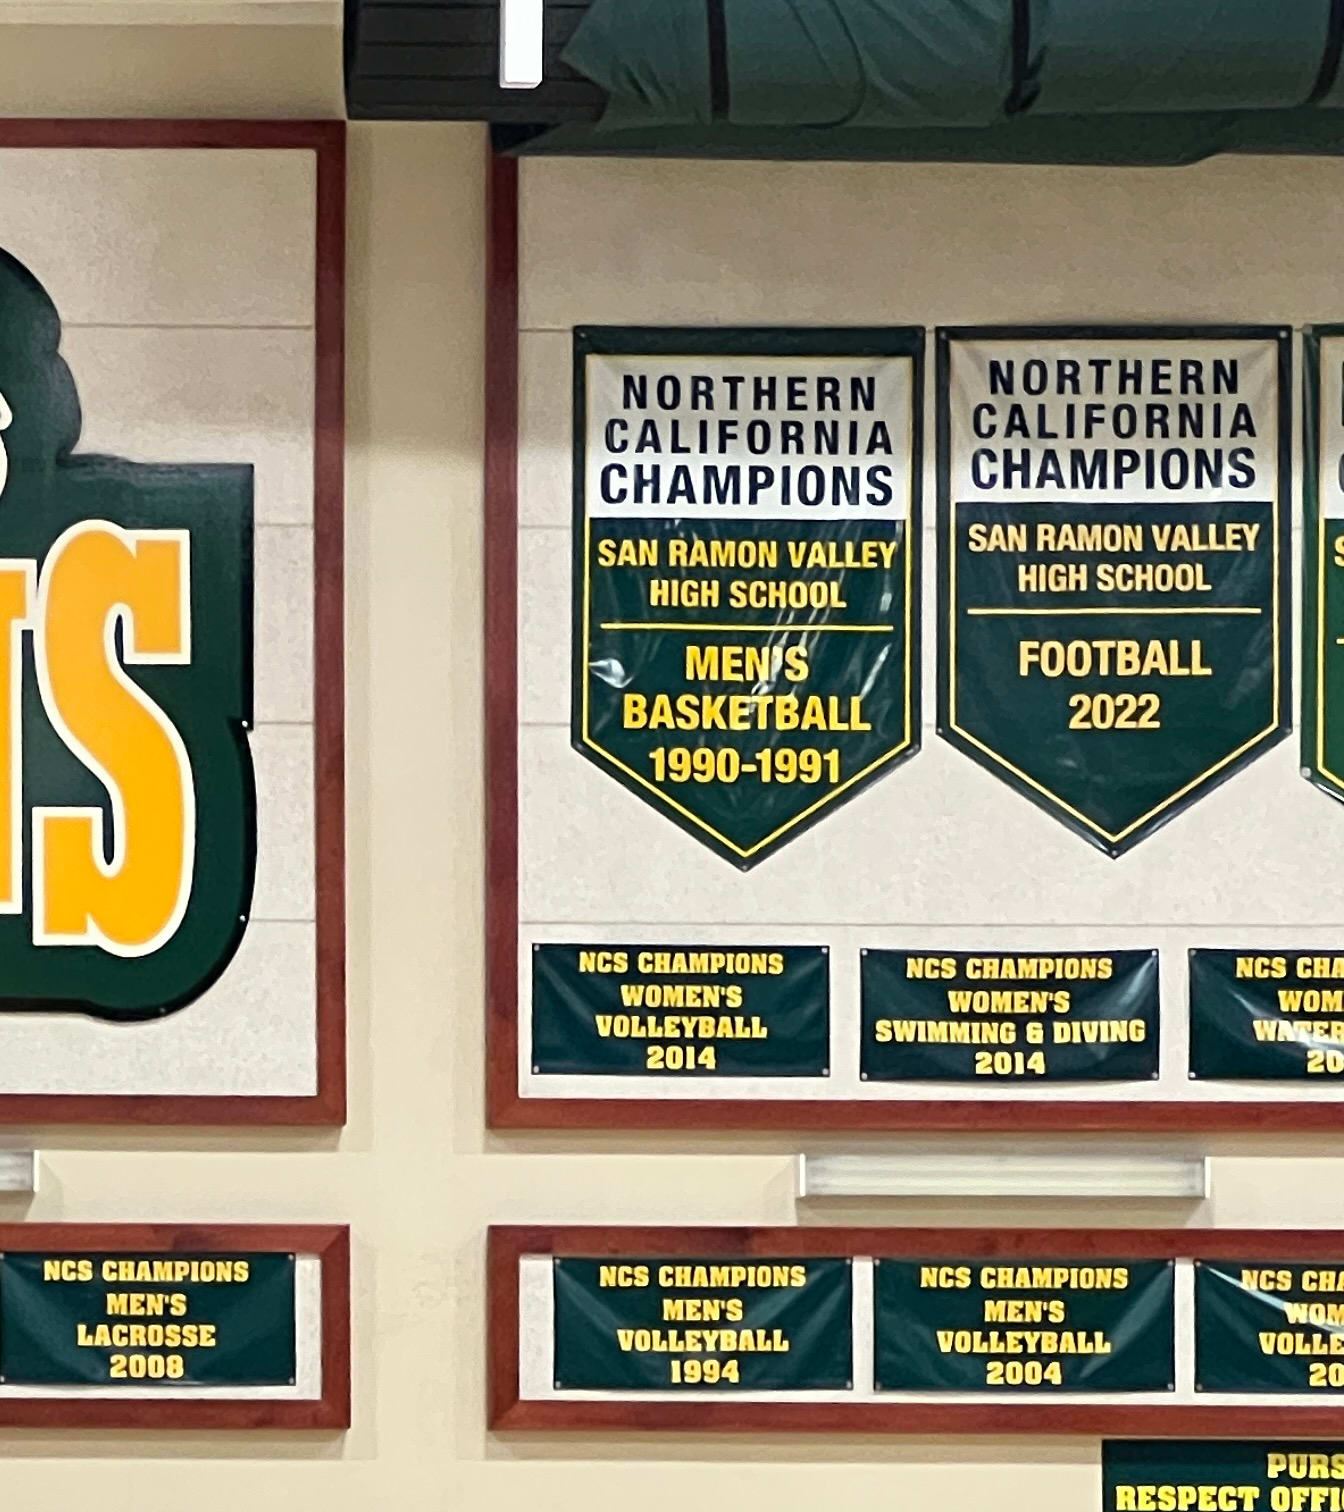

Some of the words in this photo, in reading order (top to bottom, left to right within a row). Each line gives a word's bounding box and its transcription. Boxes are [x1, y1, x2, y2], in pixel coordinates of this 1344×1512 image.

[988, 359, 1239, 396] NORTHERN
[622, 374, 877, 412] NORTHERN
[972, 402, 1257, 439] CALIFORNIA
[605, 418, 893, 455] CALIFORNIA
[970, 447, 1256, 490] CHAMPIONS
[600, 463, 894, 506] CHAMPIONS
[968, 523, 1027, 552] SAN
[1036, 523, 1143, 552] RAMON
[1151, 523, 1260, 552] VALLEY
[598, 538, 658, 569] SAN
[668, 538, 778, 569] RAMON
[787, 538, 899, 569] VALLEY
[1018, 563, 1088, 592] HIGH
[1097, 563, 1212, 592] SCHOOL
[649, 579, 720, 610] HIGH
[729, 579, 847, 610] SCHOOL
[685, 644, 809, 683] MEN'S
[1019, 639, 1213, 677] FOOTBALL
[622, 692, 872, 732] BASKETBALL
[1069, 693, 1161, 730] 2022
[649, 747, 841, 784] 1990-1991
[579, 951, 629, 975] NCS
[637, 951, 784, 975] CHAMPIONS
[906, 957, 957, 980] NCS
[965, 957, 1113, 980] CHAMPIONS
[1236, 956, 1287, 979] NCS
[620, 984, 743, 1008] WOMEN'S
[948, 990, 1070, 1014] WOMEN'S
[595, 1014, 768, 1039] VOLLEYBALL
[875, 1019, 1017, 1045] SWIMMING
[1025, 1019, 1044, 1045] &
[1052, 1019, 1146, 1045] DIVING
[1252, 1019, 1344, 1044] WATER
[646, 1045, 717, 1070] 2014
[975, 1051, 1046, 1075] 2014
[43, 1259, 93, 1283] NCS
[101, 1259, 249, 1283] CHAMPIONS
[599, 1265, 650, 1288] NCS
[658, 1265, 807, 1288] CHAMPIONS
[920, 1266, 972, 1289] NCS
[980, 1266, 1128, 1289] CHAMPIONS
[1241, 1269, 1293, 1292] NCS
[106, 1292, 187, 1317] MEN'S
[662, 1298, 743, 1322] MEN'S
[984, 1299, 1065, 1323] MEN'S
[77, 1324, 216, 1348] LACROSSE
[617, 1328, 790, 1353] VOLLEYBALL
[936, 1330, 1112, 1354] VOLLEYBALL
[110, 1353, 185, 1379] 2008
[669, 1358, 740, 1384] 1994
[985, 1360, 1062, 1385] 2004
[1115, 1485, 1260, 1512] RESPECT
[1270, 1486, 1344, 1512] OFFI
